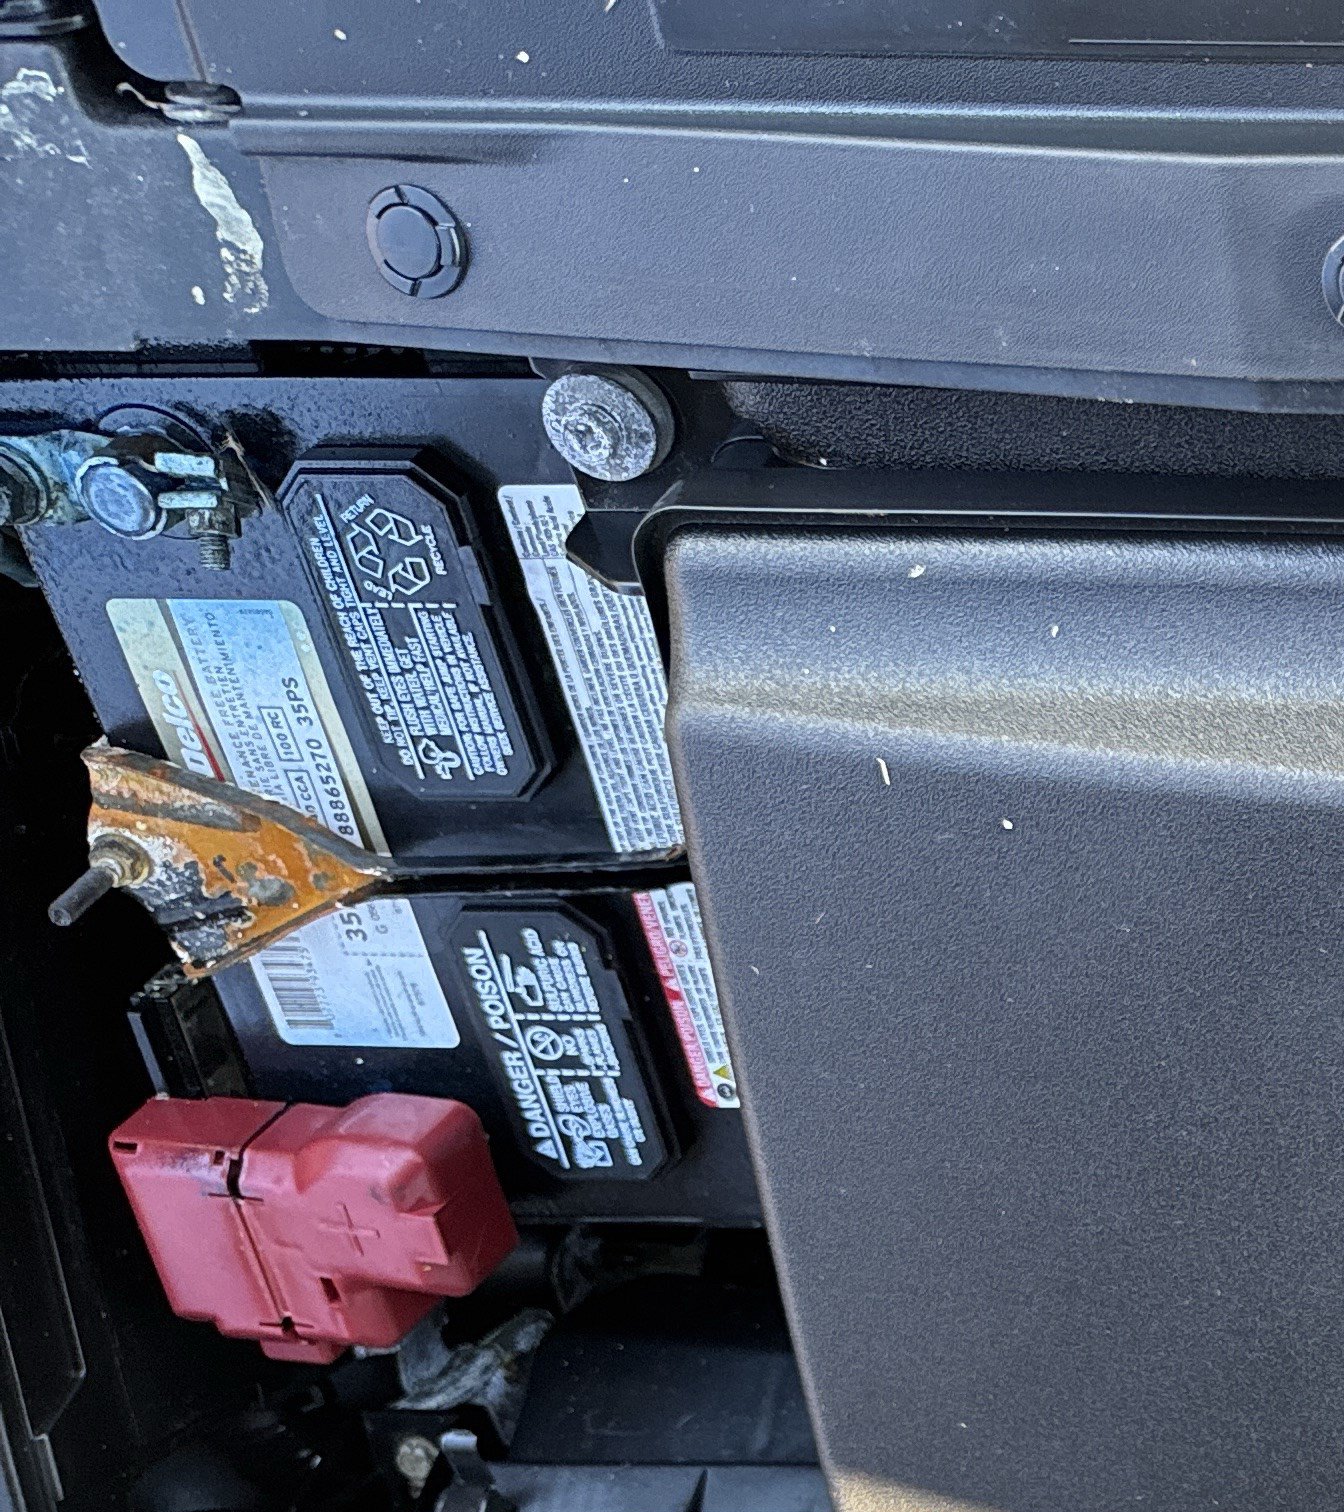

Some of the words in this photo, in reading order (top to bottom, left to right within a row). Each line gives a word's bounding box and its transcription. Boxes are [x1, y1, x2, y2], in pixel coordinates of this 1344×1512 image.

[338, 492, 375, 523] RETURN
[312, 515, 333, 546] LEVEL
[325, 551, 343, 572] AND
[419, 524, 448, 574] RECYCLE
[308, 537, 338, 590] CHILDREN
[328, 593, 345, 608] OF
[335, 576, 356, 606] TIGHT
[335, 611, 359, 646] REACH
[348, 612, 368, 638] CAPS
[417, 610, 443, 656] STARTING
[180, 615, 218, 685] BATTERY
[364, 607, 401, 673] IMMEDIATELY
[404, 635, 426, 662] FAST
[203, 612, 255, 719] MANTENIMIENTO
[350, 649, 368, 670] THE
[359, 641, 379, 668] VENT
[394, 646, 414, 668] GET
[359, 674, 375, 688] OF
[414, 663, 436, 690] HELP
[458, 660, 476, 680] NOT
[370, 672, 391, 699] KEEP
[390, 675, 411, 700] EYES
[210, 690, 234, 726] FREE
[213, 665, 250, 736] ENTRETIEN
[280, 677, 313, 726] 35PS
[365, 692, 384, 713] OUT
[424, 691, 453, 735] MEDICAL
[147, 670, 214, 779] Delco
[248, 725, 262, 739] DE
[267, 711, 283, 728] RC
[374, 716, 395, 743] KEEP
[399, 702, 424, 736] FLUSH
[416, 709, 438, 734] WITH
[454, 712, 470, 730] FOR
[275, 733, 294, 755] 100
[389, 724, 408, 746] NOT
[244, 741, 264, 771] SANS
[256, 745, 279, 779] LIBRE
[397, 749, 414, 764] DO
[293, 777, 312, 800] CCA
[304, 739, 354, 834] 88865270
[338, 912, 368, 941] 35
[519, 928, 545, 956] ACID
[459, 946, 512, 1029] POISON
[559, 1034, 579, 1054] NO
[497, 1050, 552, 1137] DANGER
